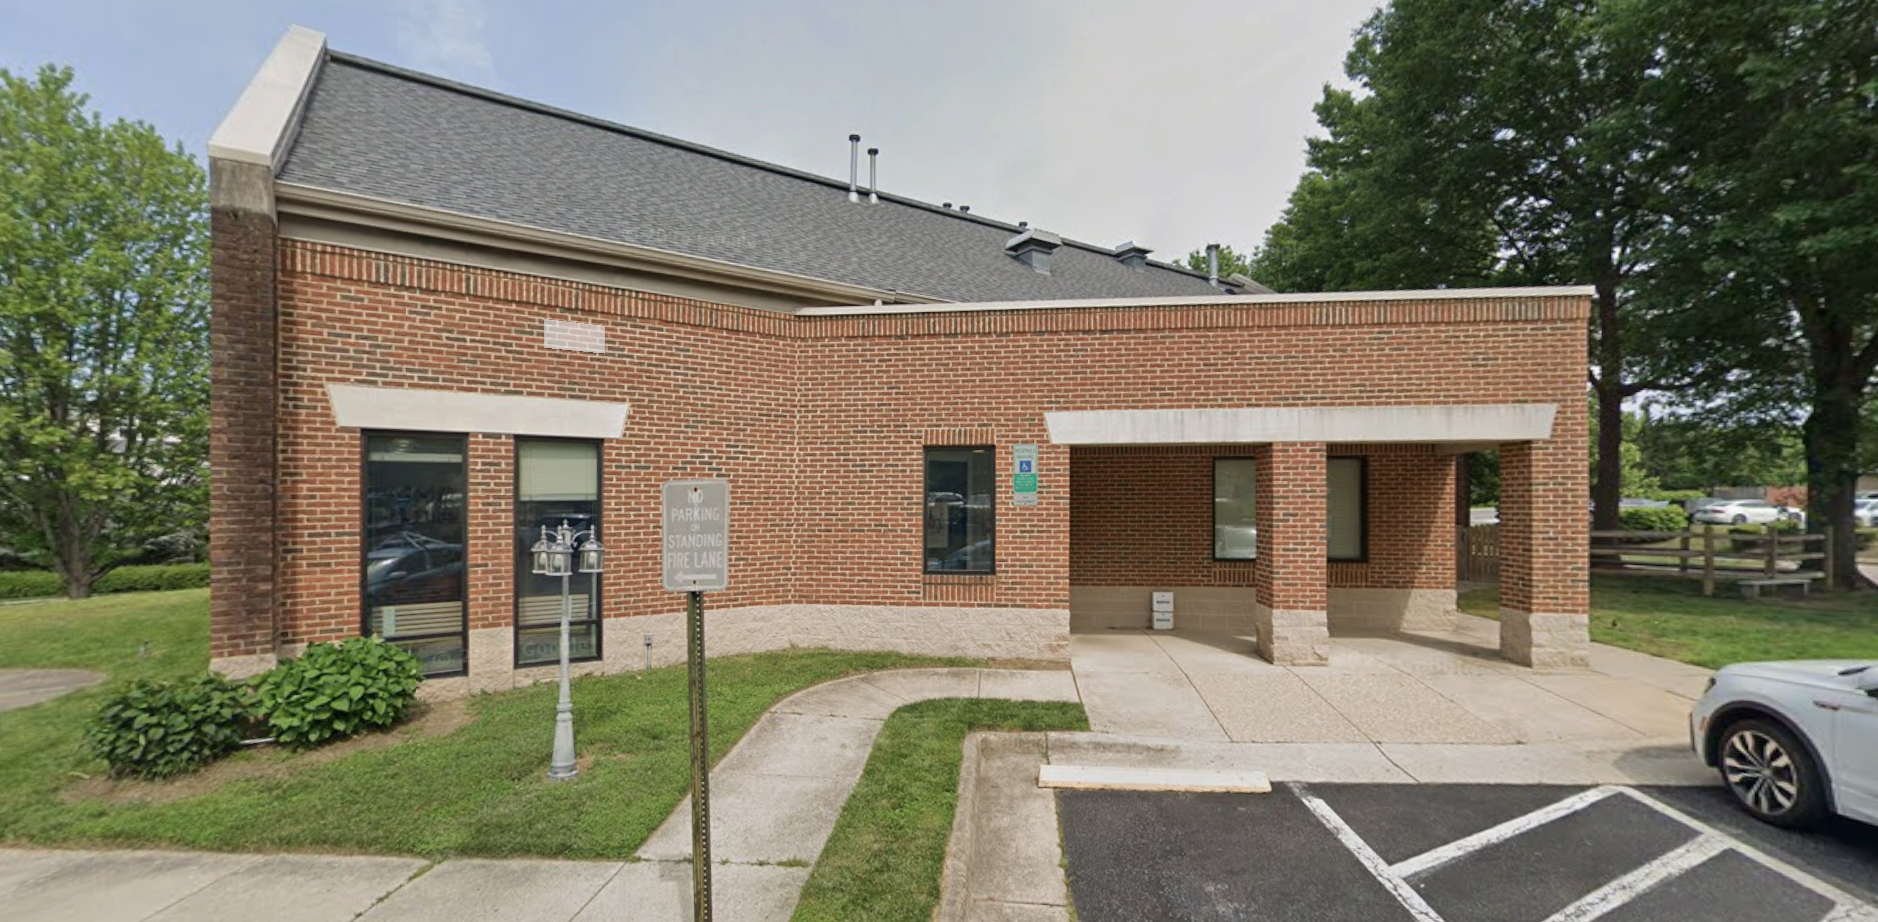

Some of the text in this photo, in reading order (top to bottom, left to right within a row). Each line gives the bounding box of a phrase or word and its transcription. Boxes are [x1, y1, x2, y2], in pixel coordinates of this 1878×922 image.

[687, 489, 704, 504] NO
[671, 507, 720, 522] PARKING
[668, 533, 723, 549] STANDING
[668, 551, 723, 569] FIRE LANE
